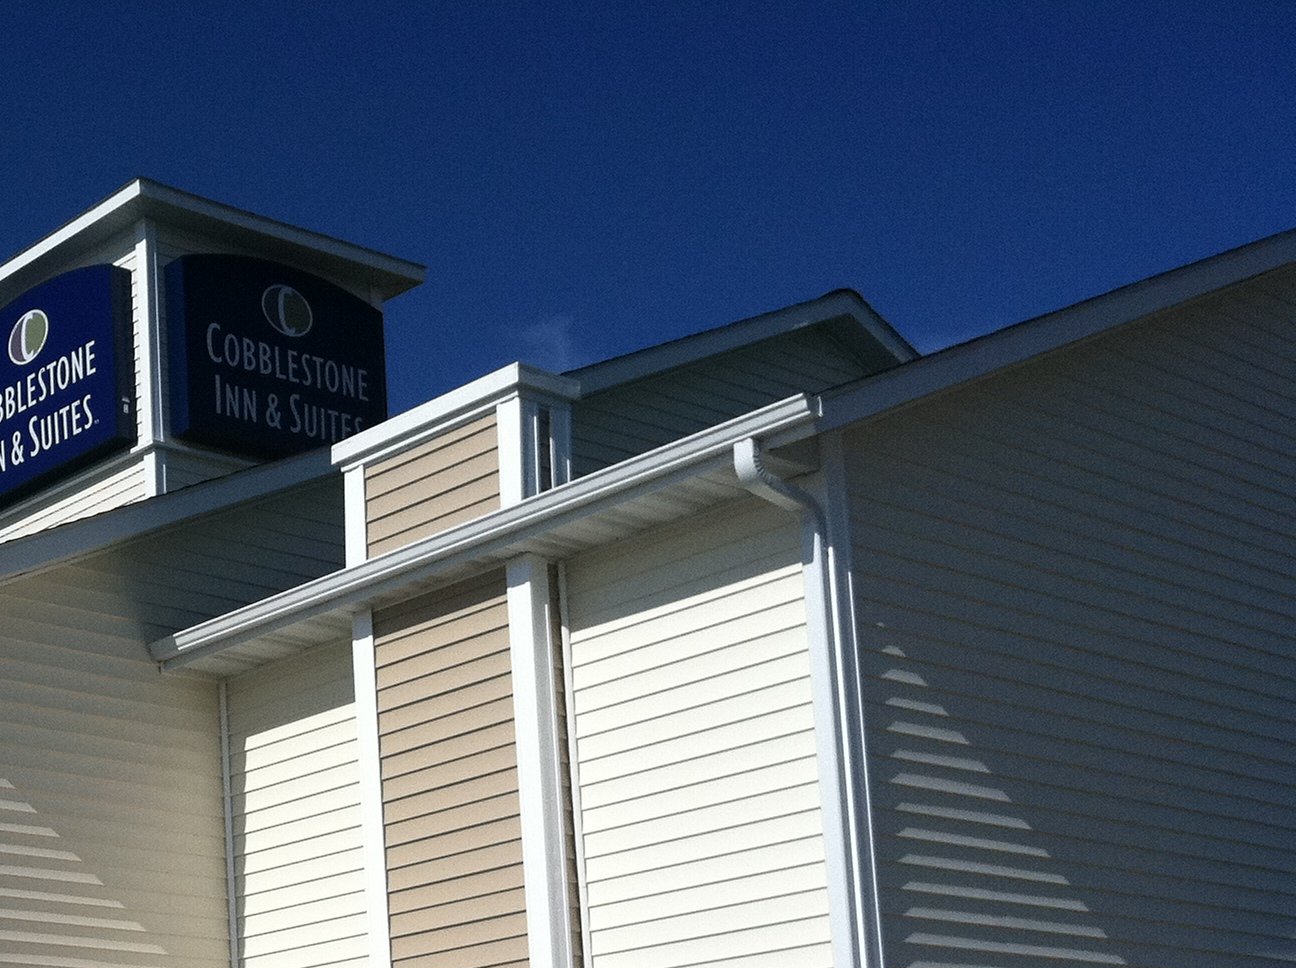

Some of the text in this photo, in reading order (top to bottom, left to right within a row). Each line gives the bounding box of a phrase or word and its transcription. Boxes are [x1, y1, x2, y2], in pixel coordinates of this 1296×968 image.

[206, 322, 369, 401] COBBLESTONE
[11, 430, 25, 466] &
[28, 394, 94, 457] SUITES
[215, 374, 257, 423] INN
[265, 393, 282, 430] &
